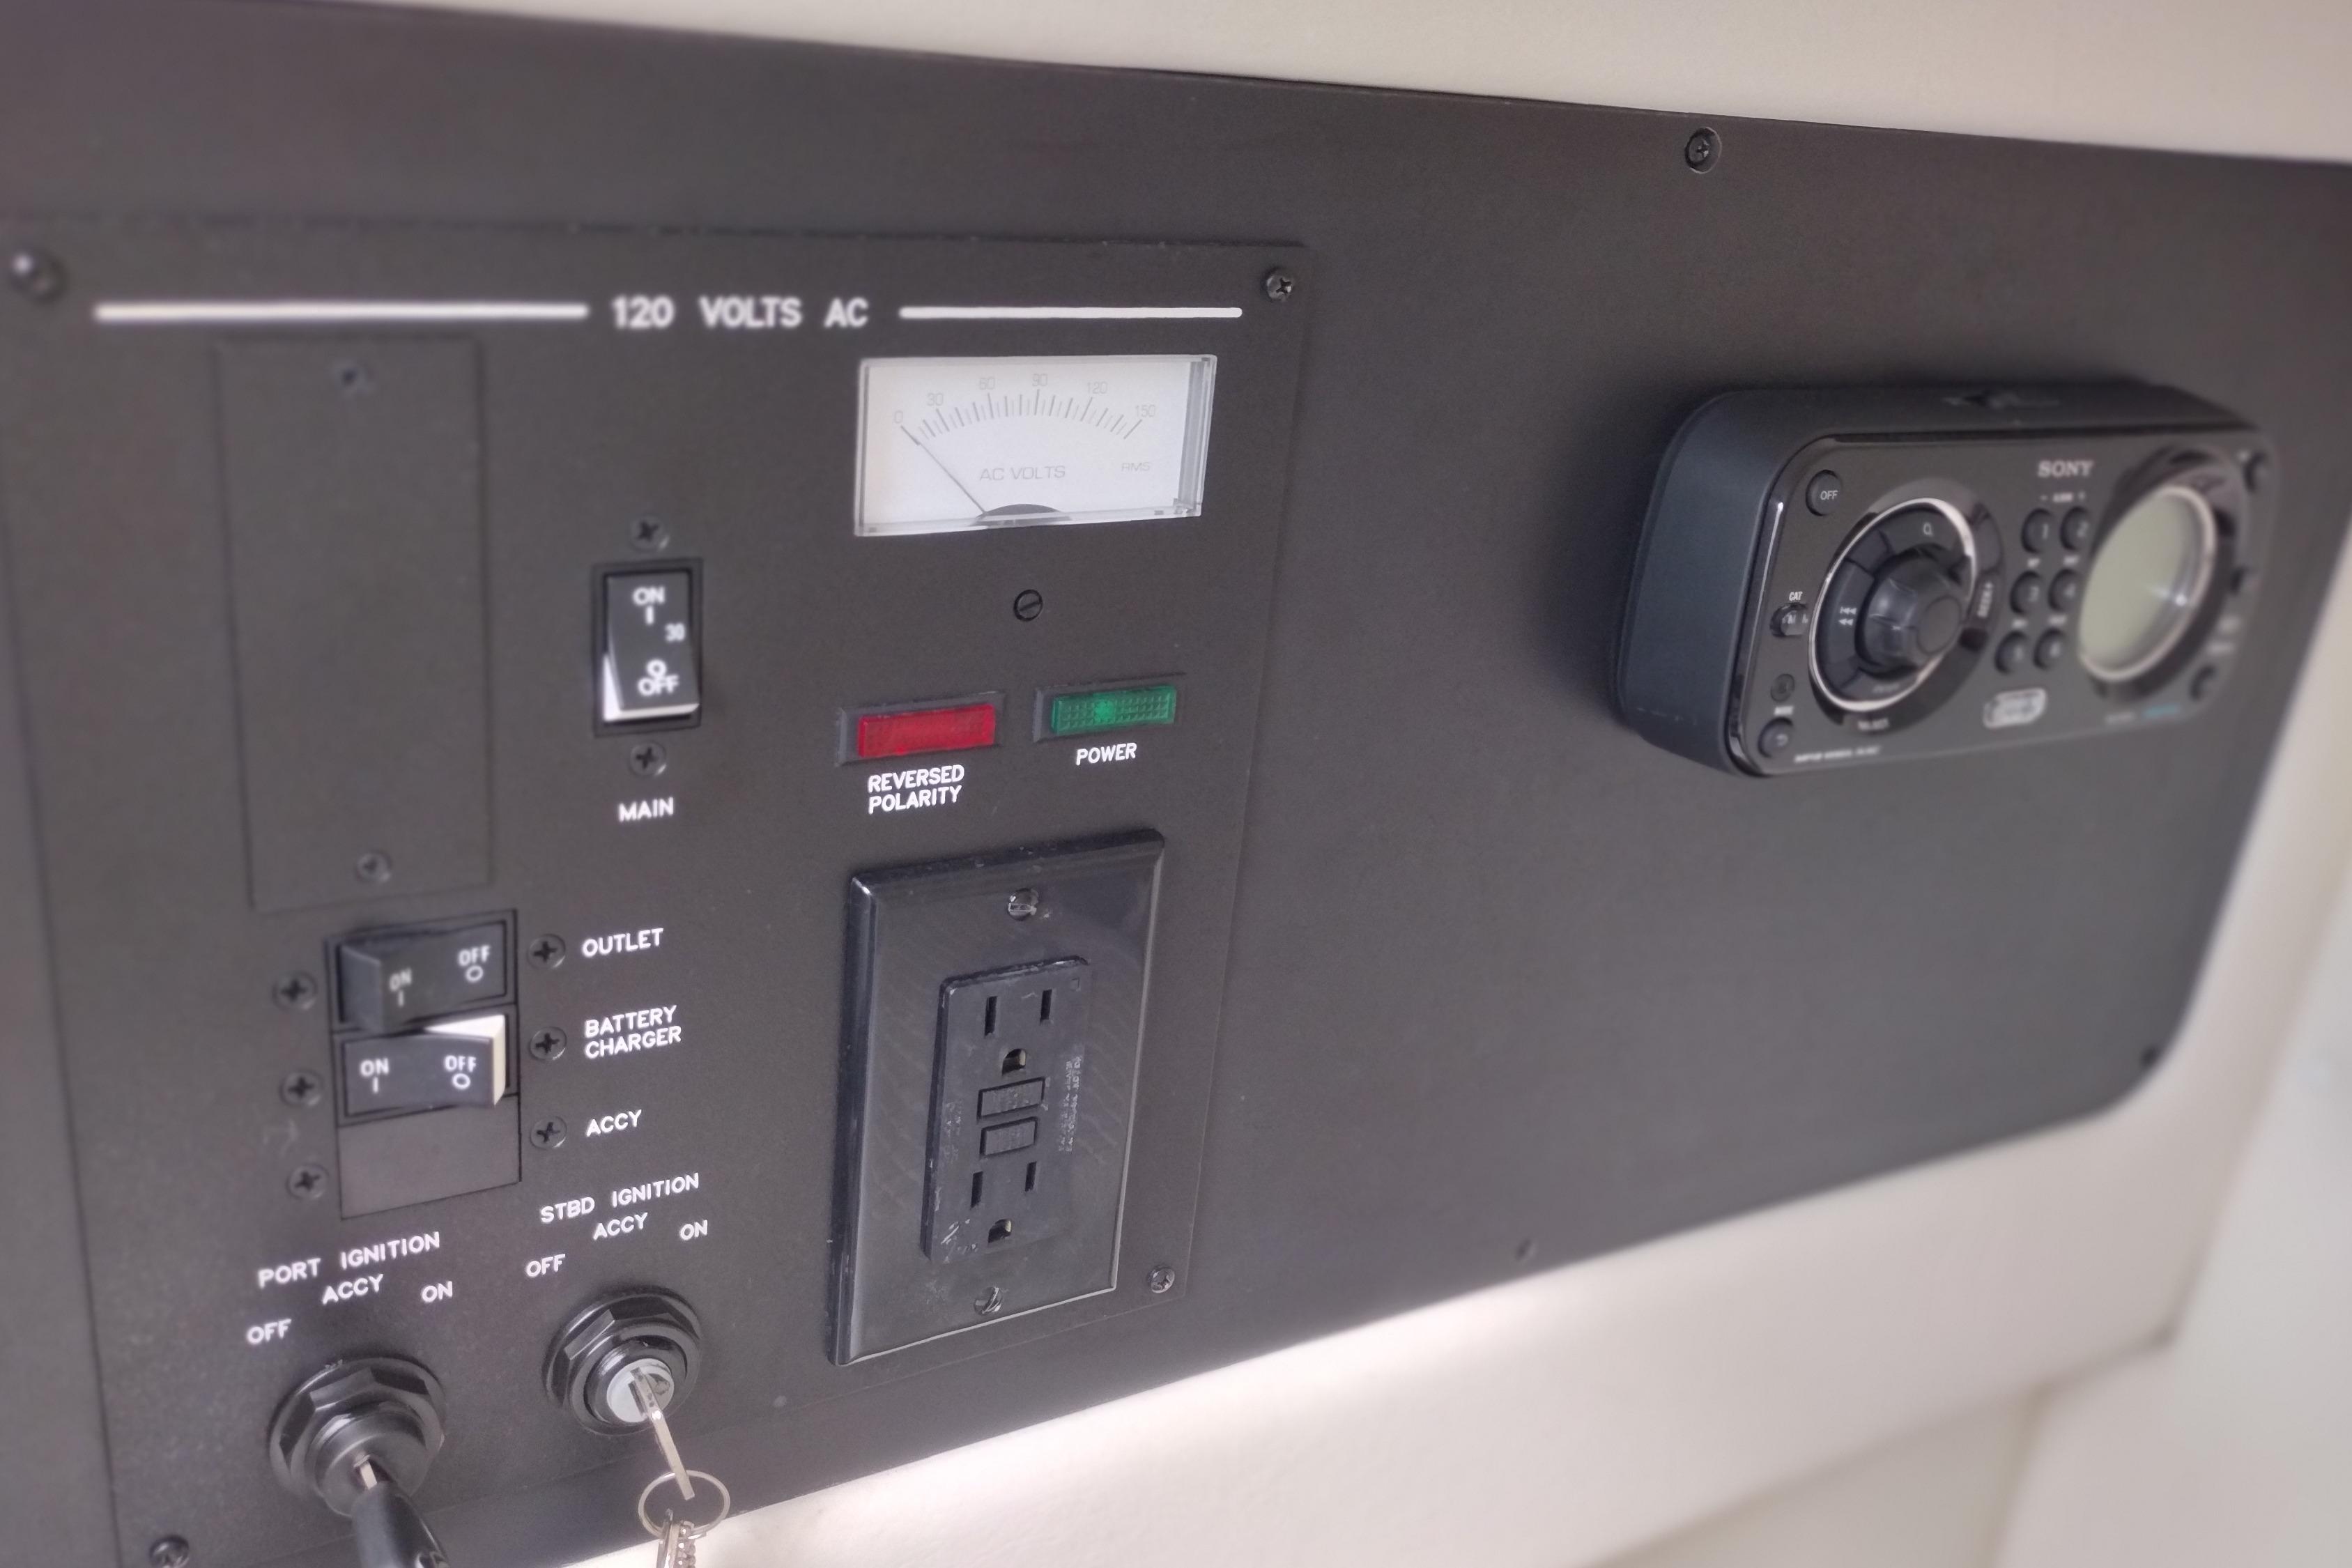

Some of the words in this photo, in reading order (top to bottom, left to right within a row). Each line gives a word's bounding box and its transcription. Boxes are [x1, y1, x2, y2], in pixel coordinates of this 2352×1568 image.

[613, 295, 675, 329] 120
[698, 295, 803, 329] VOLTS
[824, 296, 869, 328] AC
[979, 376, 996, 391] 60
[1032, 373, 1048, 387] 90
[1086, 381, 1108, 394] 120
[926, 392, 944, 407] 30
[1135, 403, 1156, 418] 150
[979, 468, 1005, 482] AC
[1010, 466, 1066, 481] VOLTS
[1121, 461, 1151, 472] RMS
[2038, 459, 2093, 478] SONY
[1820, 489, 1838, 501] OFF
[632, 586, 666, 606] ON
[1788, 591, 1803, 601] CAT
[666, 622, 686, 643] 30
[637, 674, 679, 696] OFF
[1075, 742, 1137, 766] POWER
[867, 764, 965, 793] REVERSED
[618, 797, 674, 822] MAIN
[868, 785, 962, 815] POLARITY
[581, 928, 664, 958] OUTLET
[458, 944, 491, 965] OFF
[389, 969, 413, 990] ON
[584, 1005, 677, 1038] BATTERY
[584, 1025, 682, 1059] CHARGER
[360, 1058, 390, 1077] ON
[443, 1054, 477, 1072] OFF
[585, 1109, 642, 1137] ACCY
[540, 1196, 595, 1224] STBD
[610, 1172, 699, 1208] IGNITION
[592, 1212, 648, 1240] ACCY
[679, 1219, 708, 1241] ON
[257, 1257, 321, 1289] PORT
[339, 1231, 440, 1270] IGNITION
[525, 1253, 566, 1278] OFF
[321, 1273, 384, 1305] ACCY
[420, 1280, 453, 1303] ON
[246, 1318, 292, 1345] OFF
